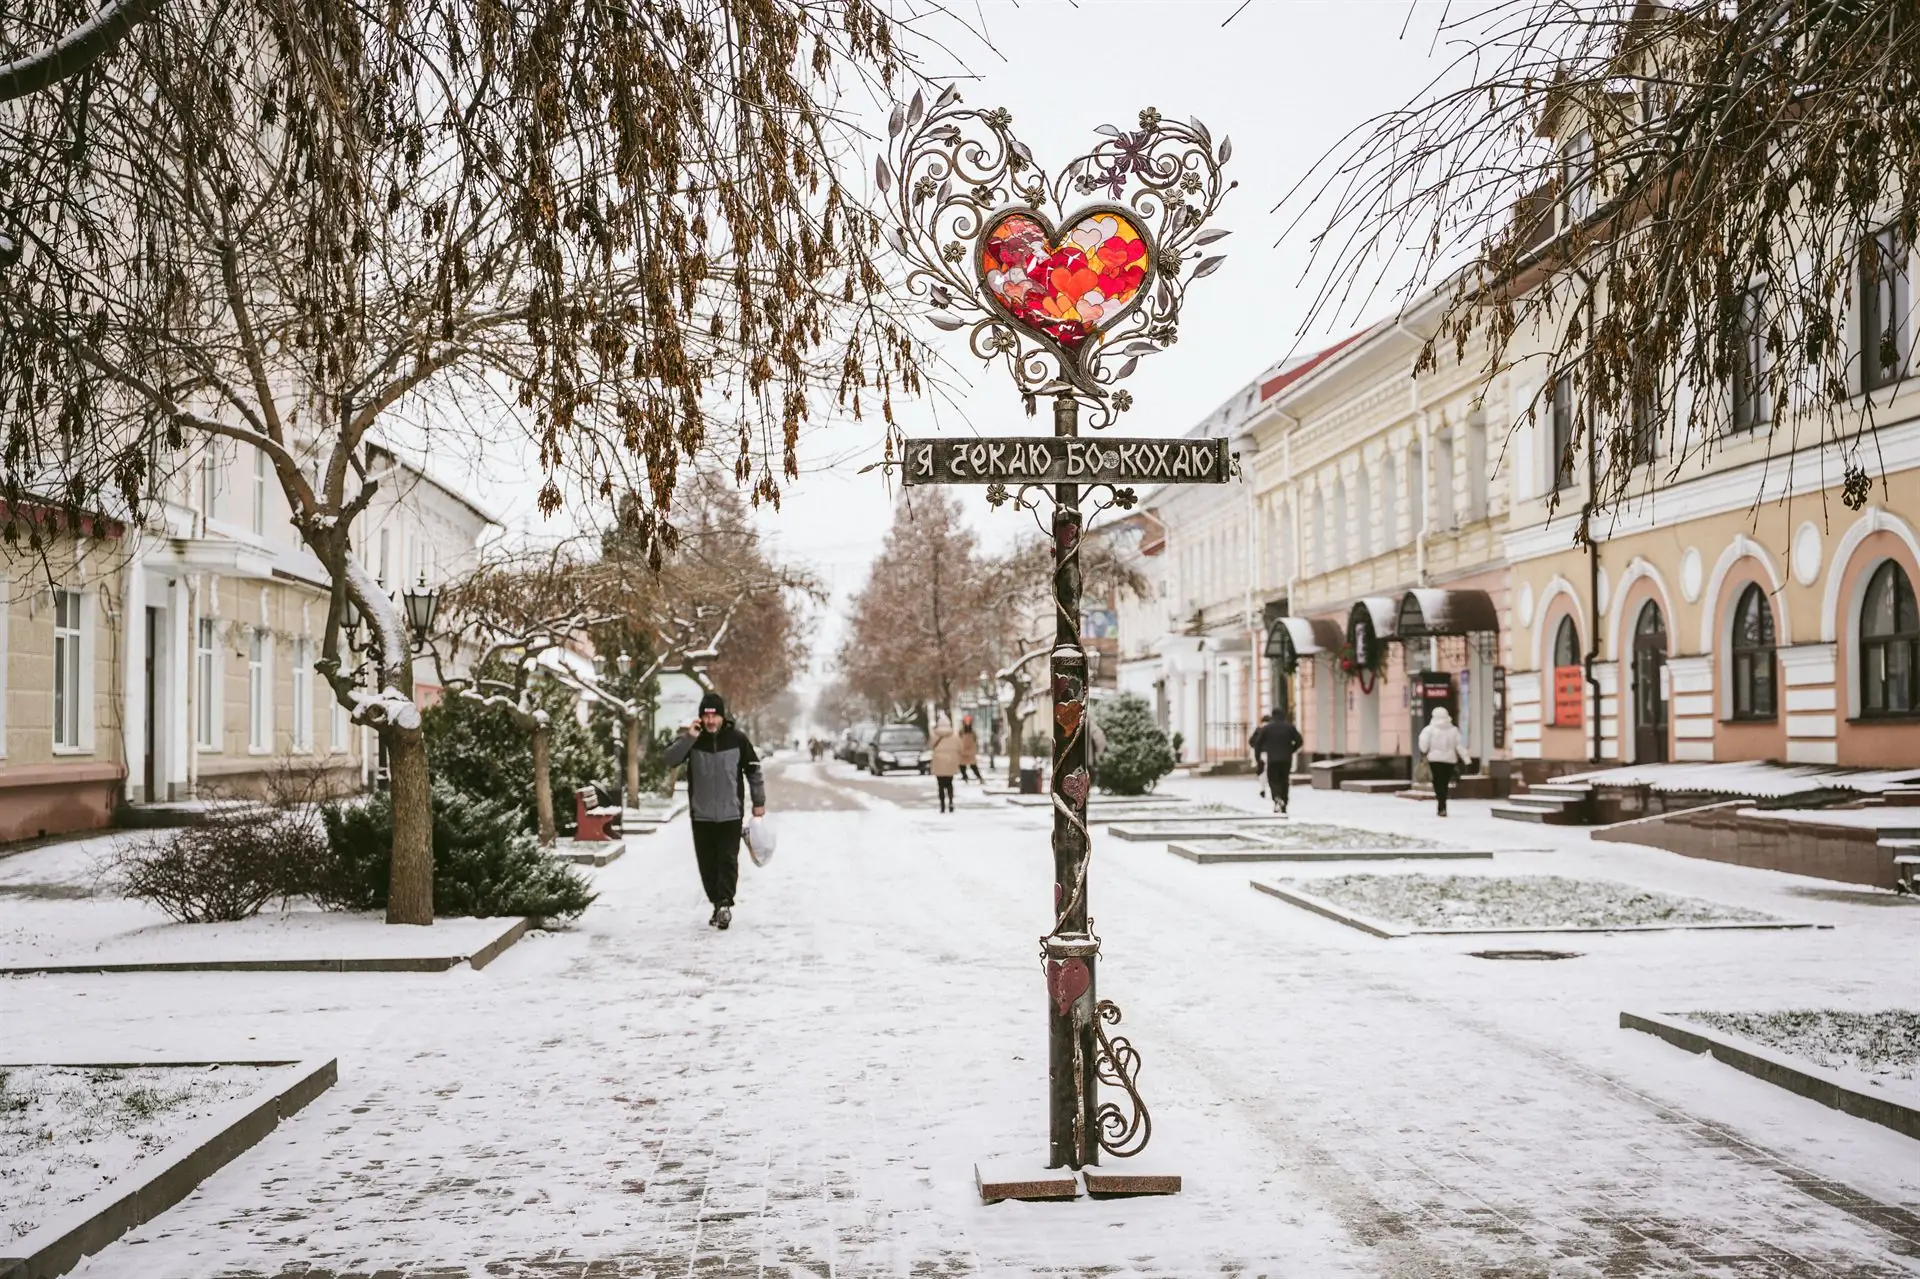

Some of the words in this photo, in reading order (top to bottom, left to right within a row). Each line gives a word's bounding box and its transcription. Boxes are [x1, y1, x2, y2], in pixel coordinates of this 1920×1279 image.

[917, 444, 934, 476] Я
[1067, 443, 1104, 475] БО
[1119, 444, 1214, 476] КОХАЮ
